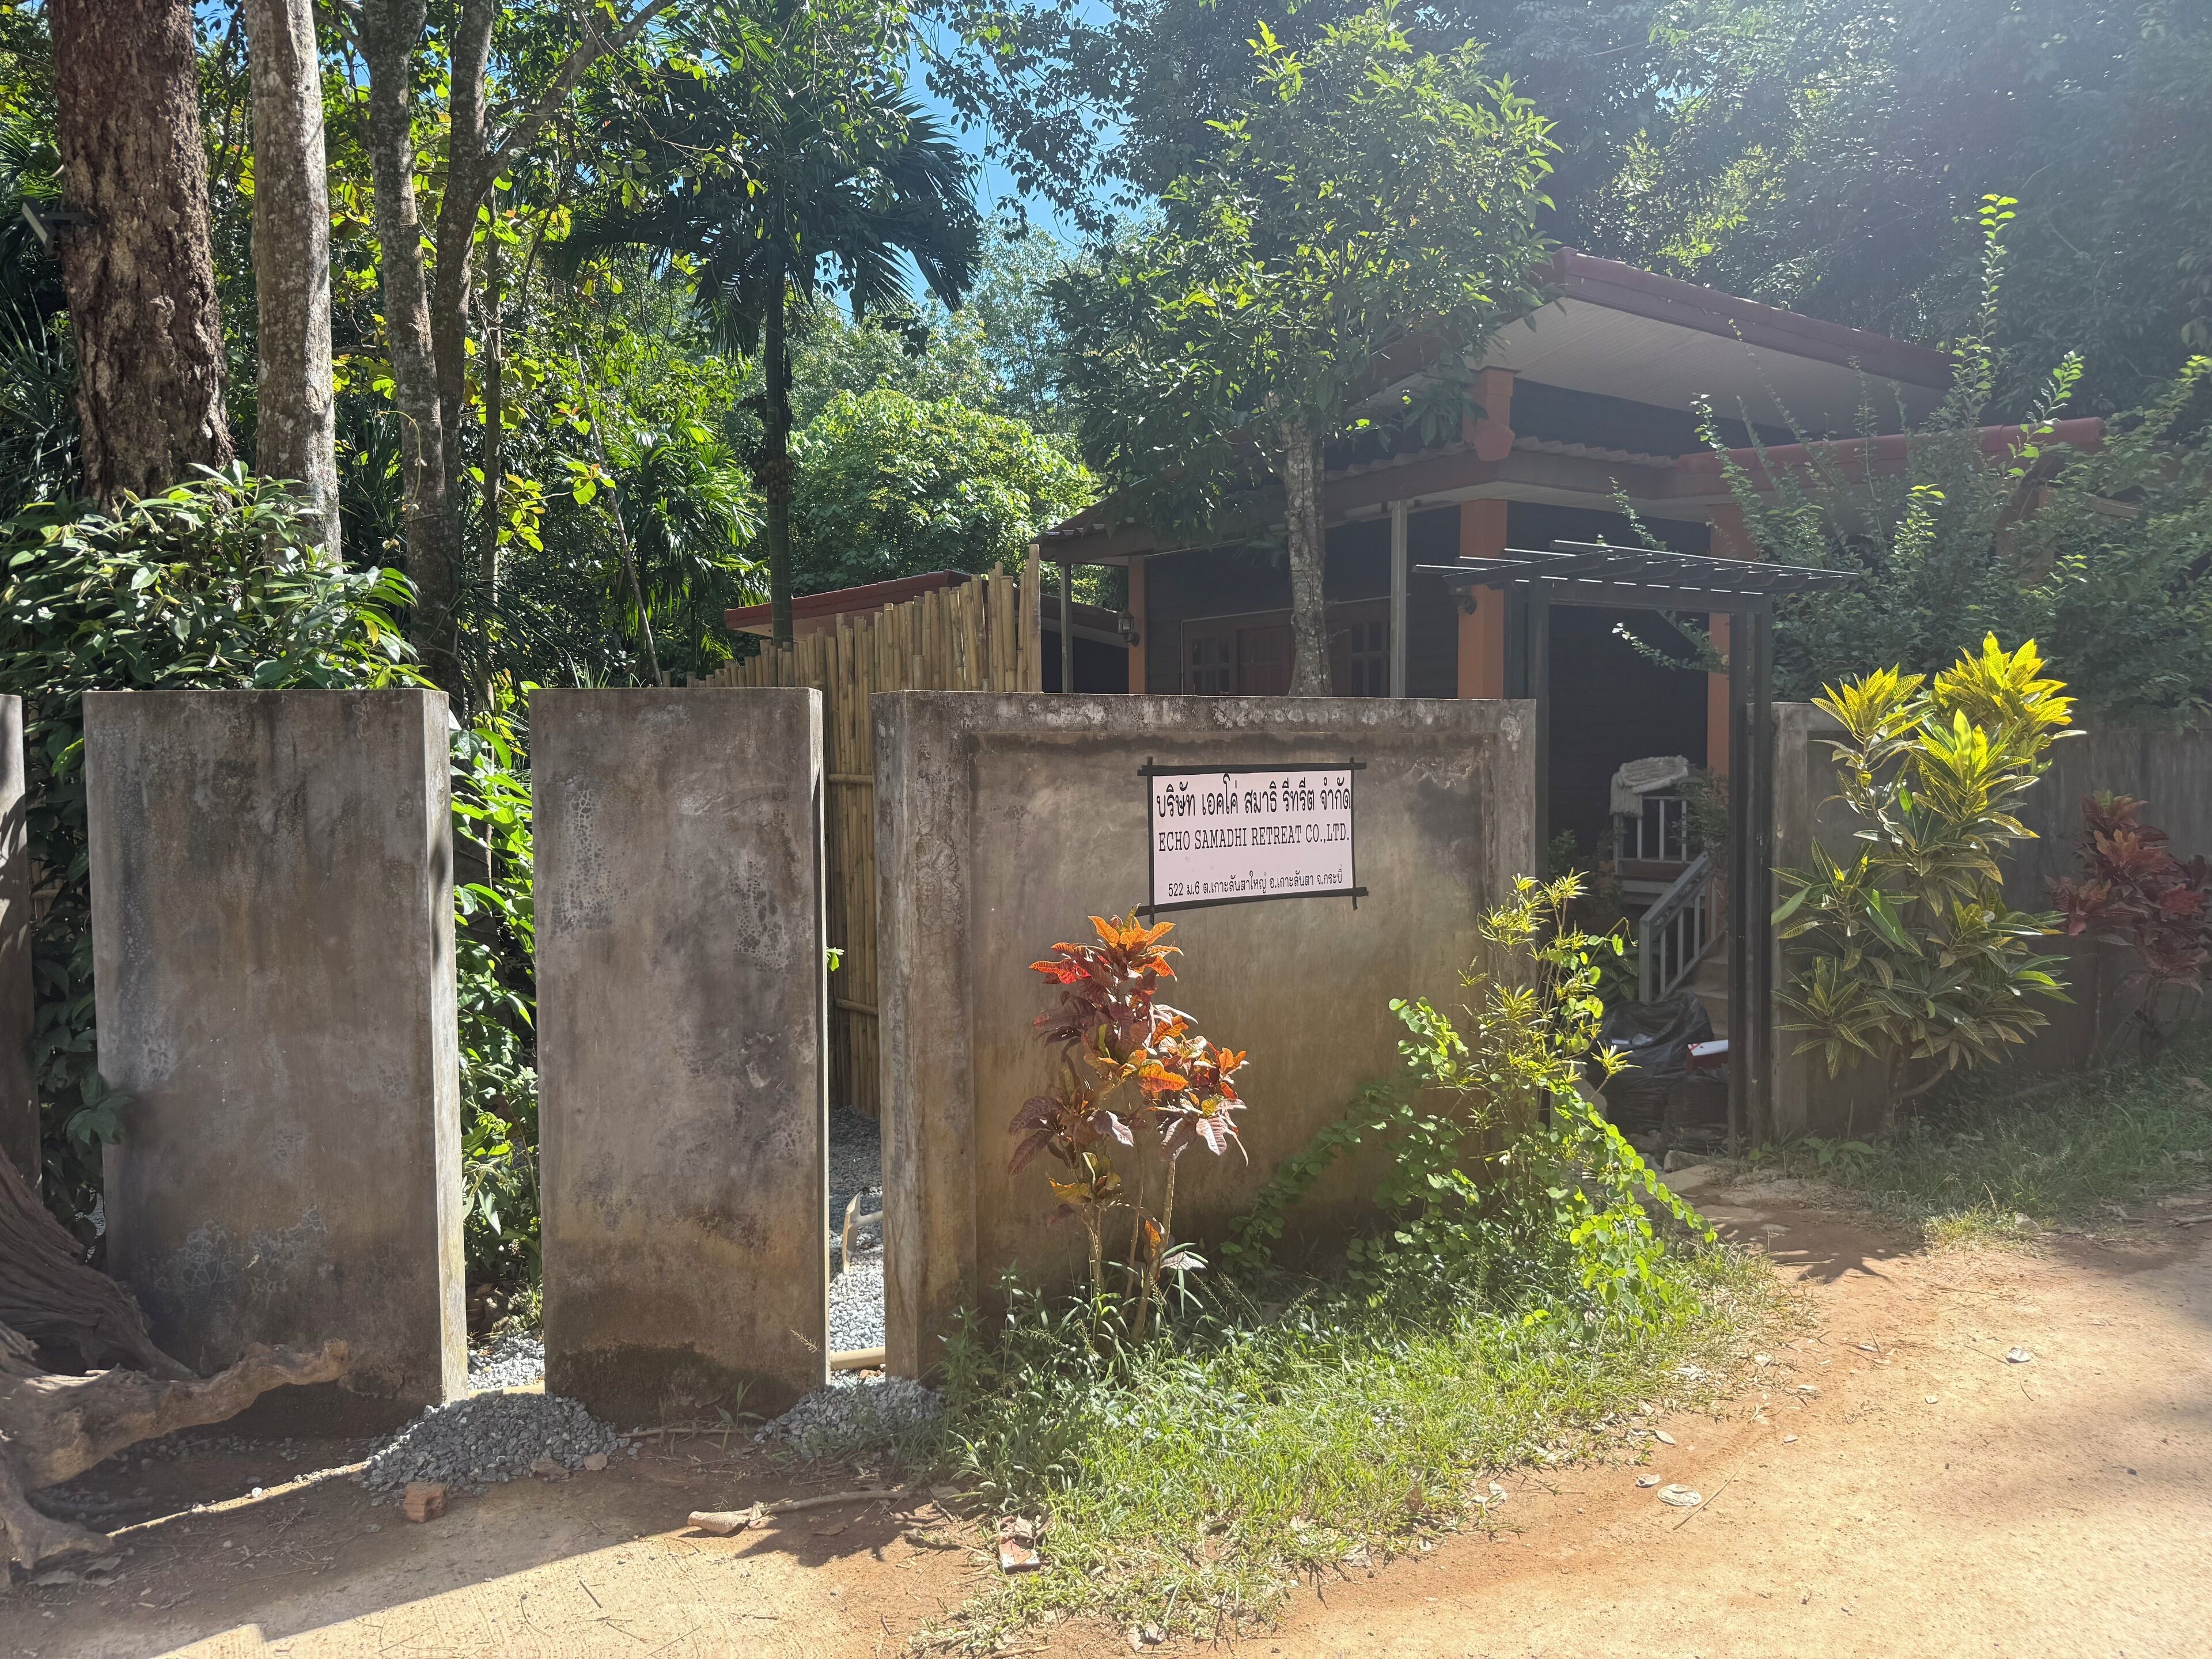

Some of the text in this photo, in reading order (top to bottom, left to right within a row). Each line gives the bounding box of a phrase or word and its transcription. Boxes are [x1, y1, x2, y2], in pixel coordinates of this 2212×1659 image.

[1157, 773, 1350, 817] บริษัท เอคโค่ สมาธิ รีทรีต จำกัด
[1158, 823, 1349, 851] ECHO SAMADHI RETREAT CO.,LTD.
[1168, 863, 1342, 897] 522 ม.6 ต.เกาะลันตาใหญ่ อ.เกาะลันตา จ.กระบี่
